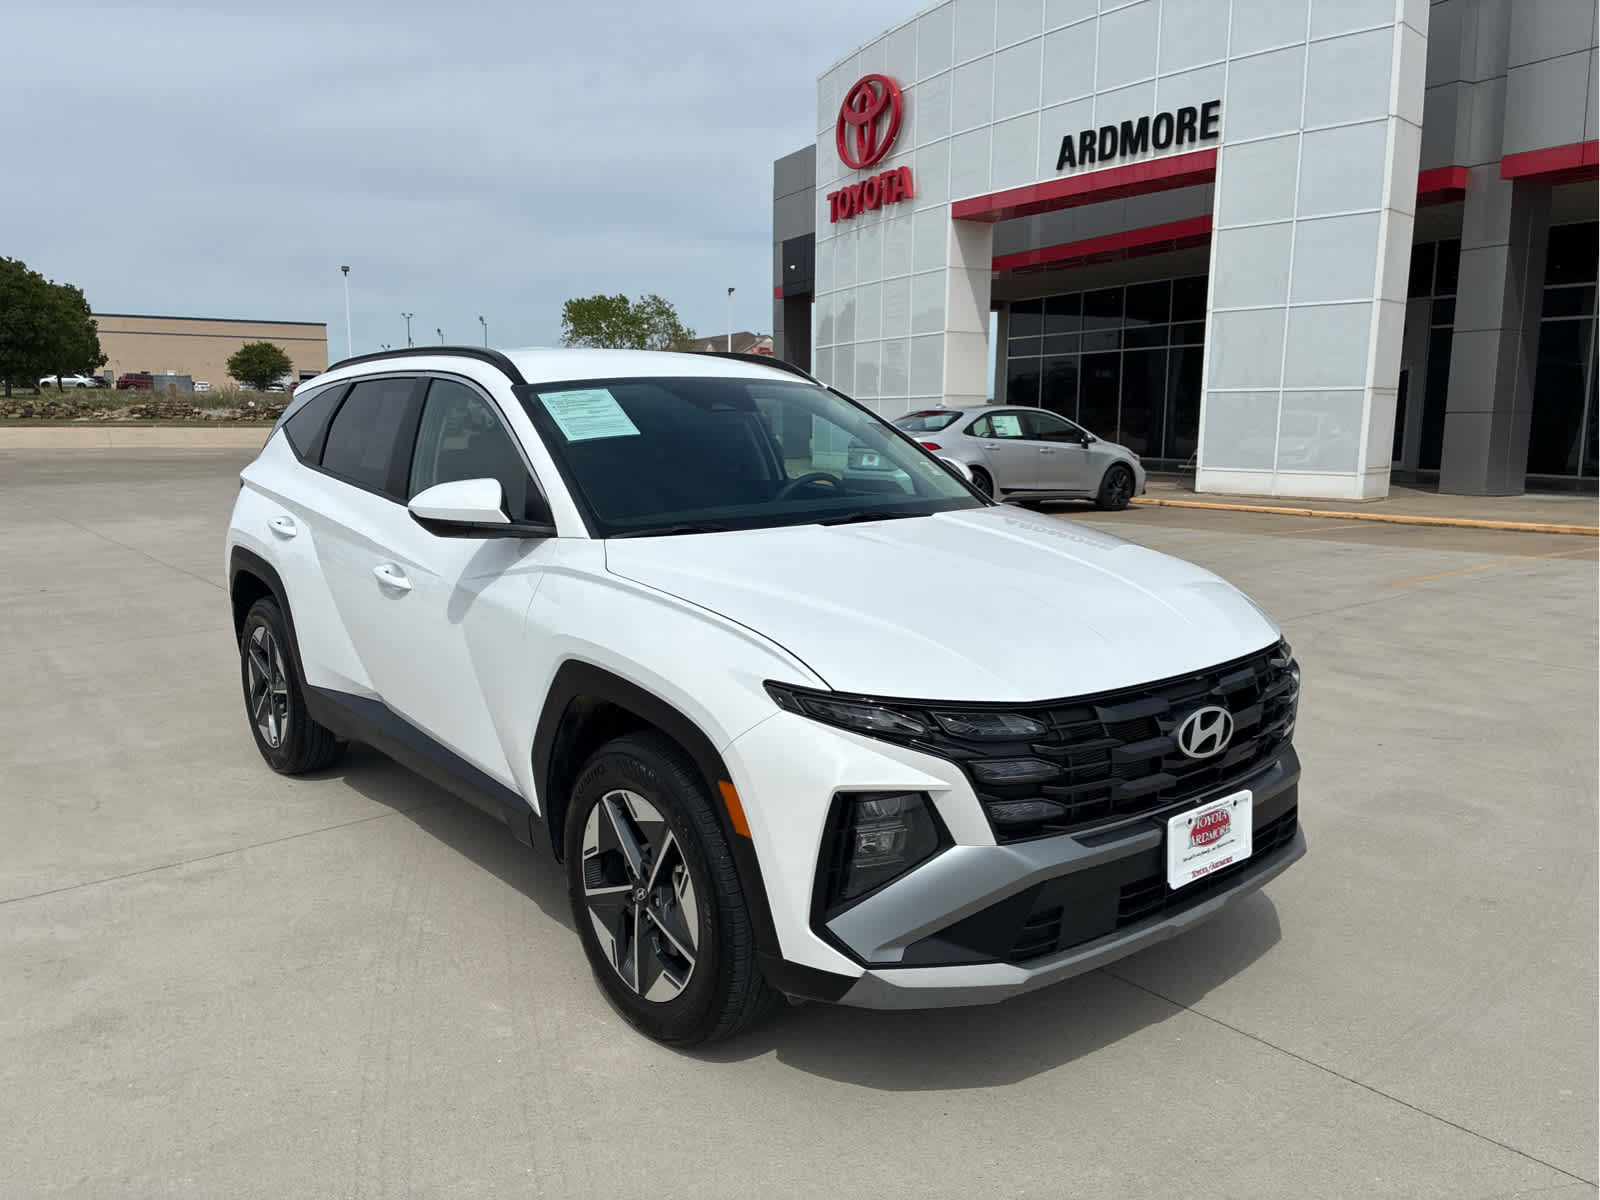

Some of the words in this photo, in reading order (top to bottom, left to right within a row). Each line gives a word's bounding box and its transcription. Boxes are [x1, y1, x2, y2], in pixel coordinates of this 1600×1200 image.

[1056, 99, 1221, 171] ARDMORE
[827, 166, 914, 223] TOYOTA
[1188, 823, 1232, 849] ARDMORE
[1195, 808, 1230, 829] TOYOTA
